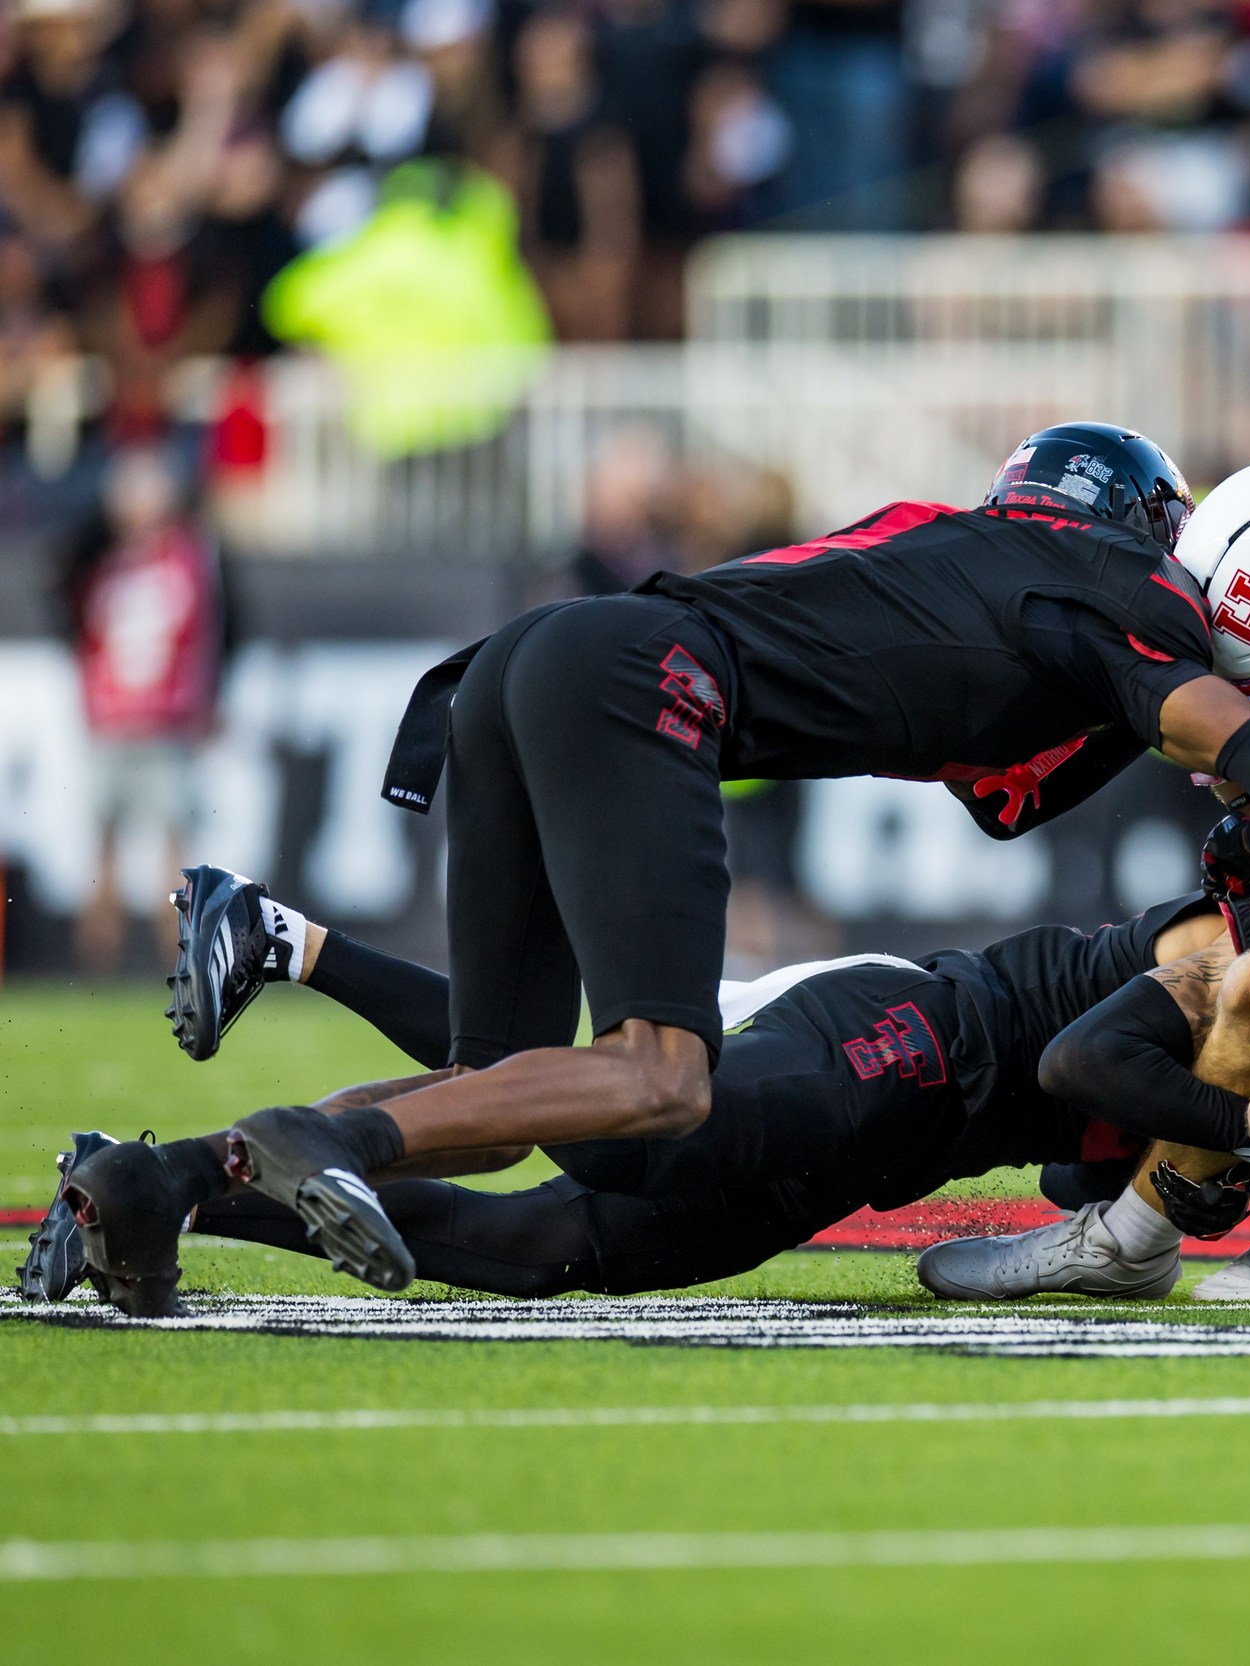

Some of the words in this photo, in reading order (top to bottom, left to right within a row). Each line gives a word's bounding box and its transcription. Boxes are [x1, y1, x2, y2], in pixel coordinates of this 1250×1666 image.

[1085, 460, 1113, 483] 832
[1005, 491, 1037, 505] Texas
[1028, 744, 1069, 778] NXTRND
[390, 786, 406, 798] WE
[405, 791, 427, 804] BALL
